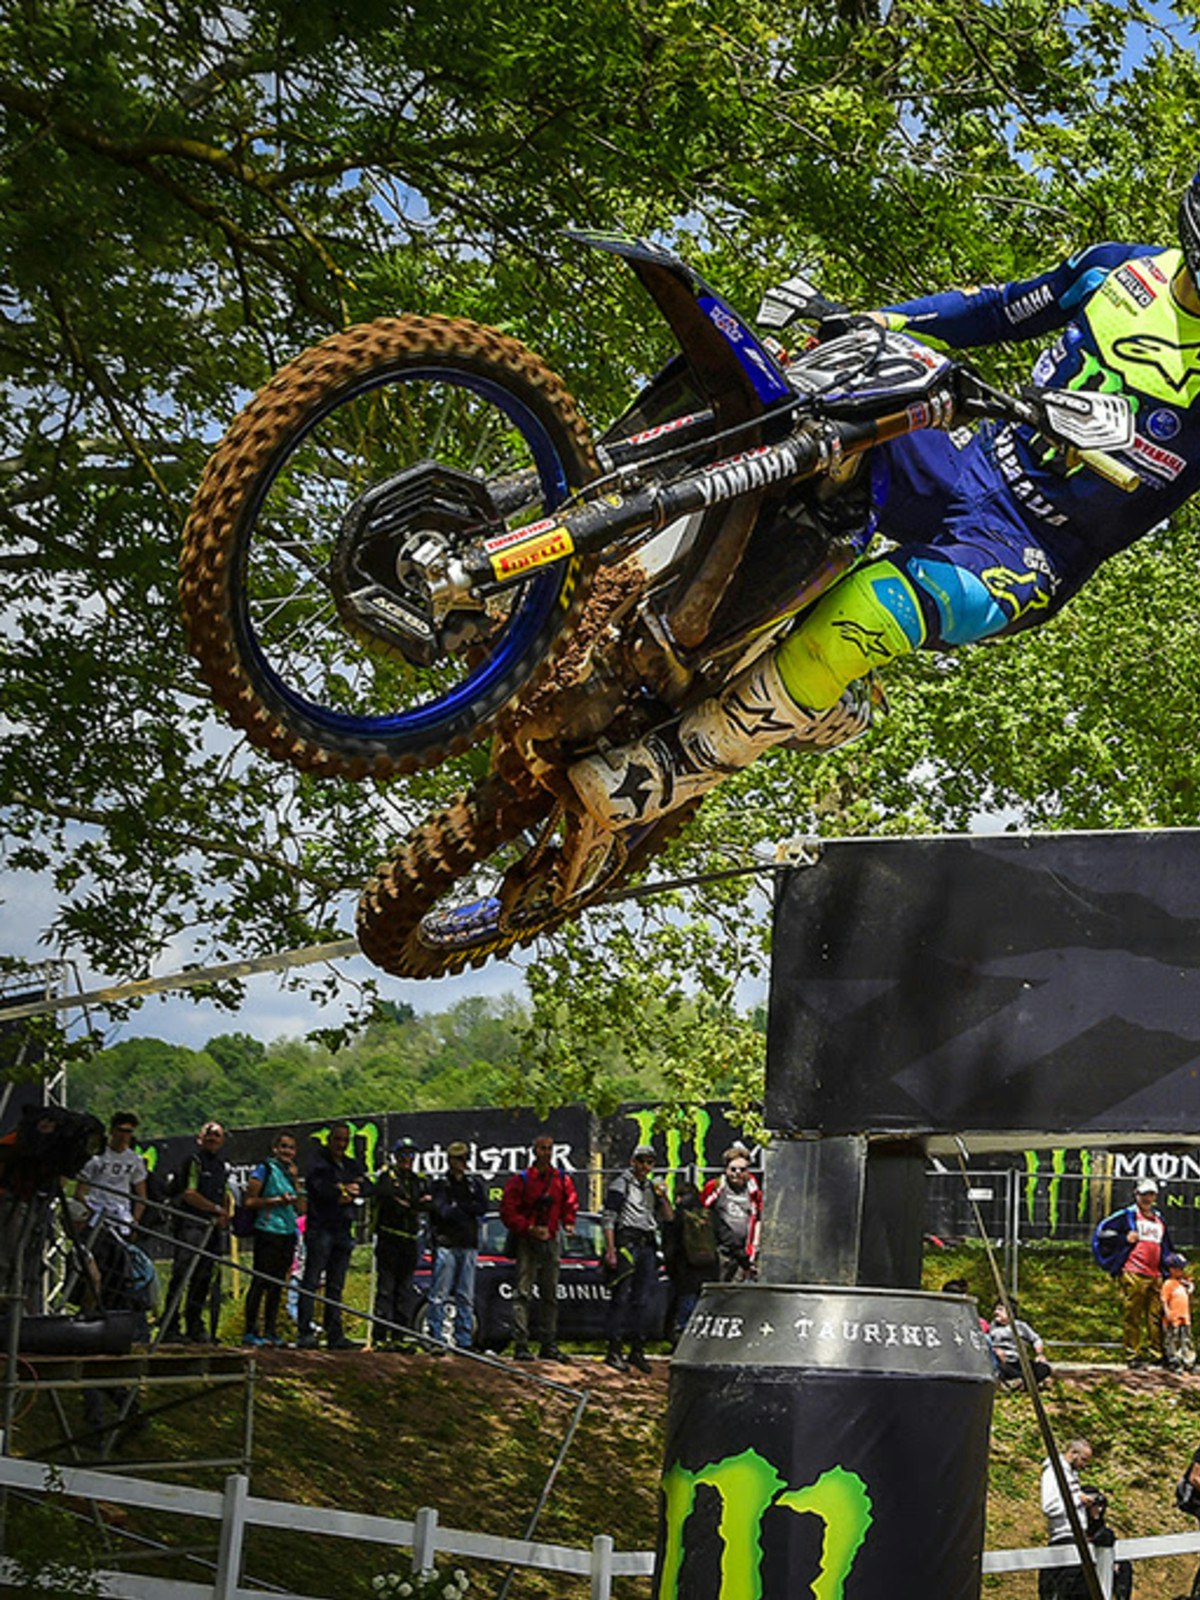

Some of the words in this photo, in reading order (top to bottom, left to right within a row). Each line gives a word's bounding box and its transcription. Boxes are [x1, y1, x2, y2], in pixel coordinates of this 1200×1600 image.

[696, 450, 798, 506] YAMAHA
[499, 535, 566, 573] PIRELLI
[391, 1143, 576, 1178] OSTR
[794, 1317, 943, 1348] TAURINE
